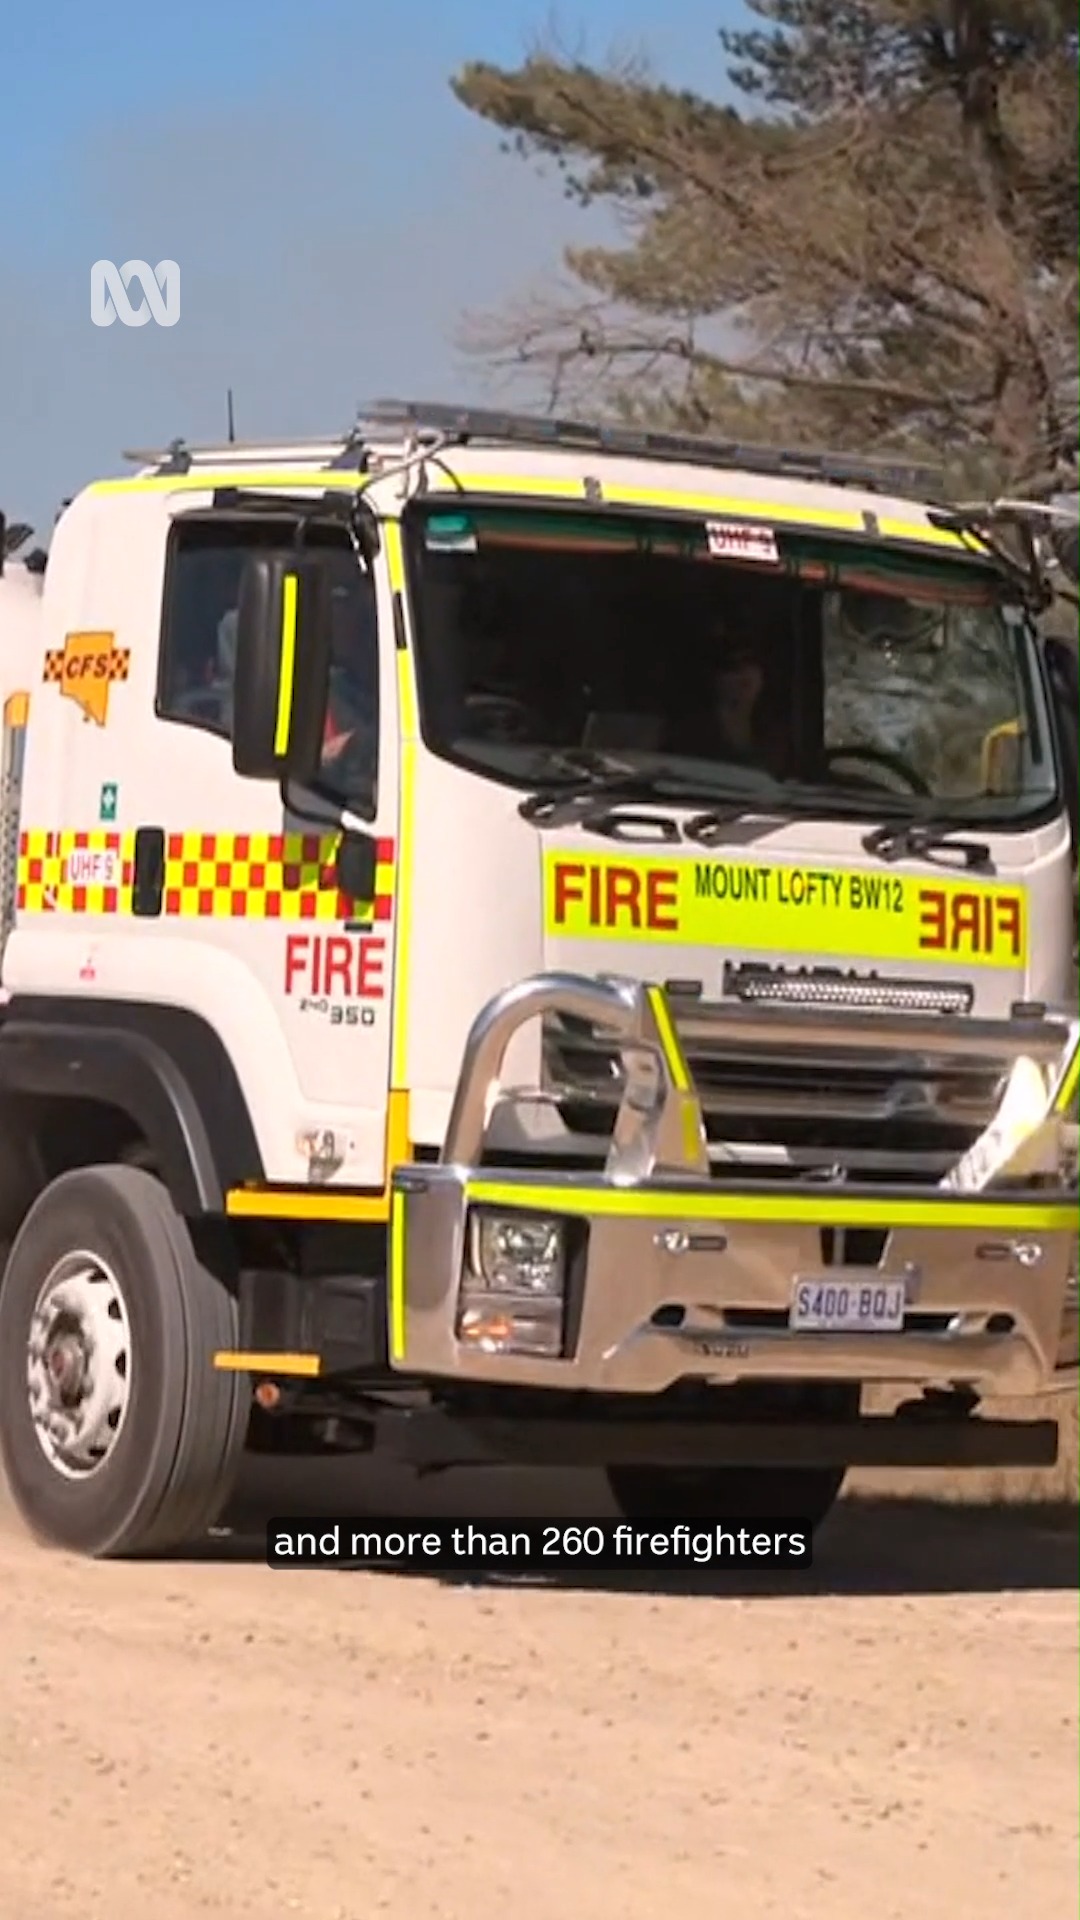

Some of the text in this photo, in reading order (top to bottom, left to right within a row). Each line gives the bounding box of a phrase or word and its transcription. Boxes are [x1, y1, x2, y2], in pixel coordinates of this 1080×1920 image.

[66, 653, 107, 679] CFS
[71, 854, 113, 880] UHF 9
[553, 863, 679, 930] FIRE
[694, 863, 904, 913] MOUNT LOFTY BW12
[284, 935, 386, 998] FIRE
[331, 1005, 375, 1027] 350
